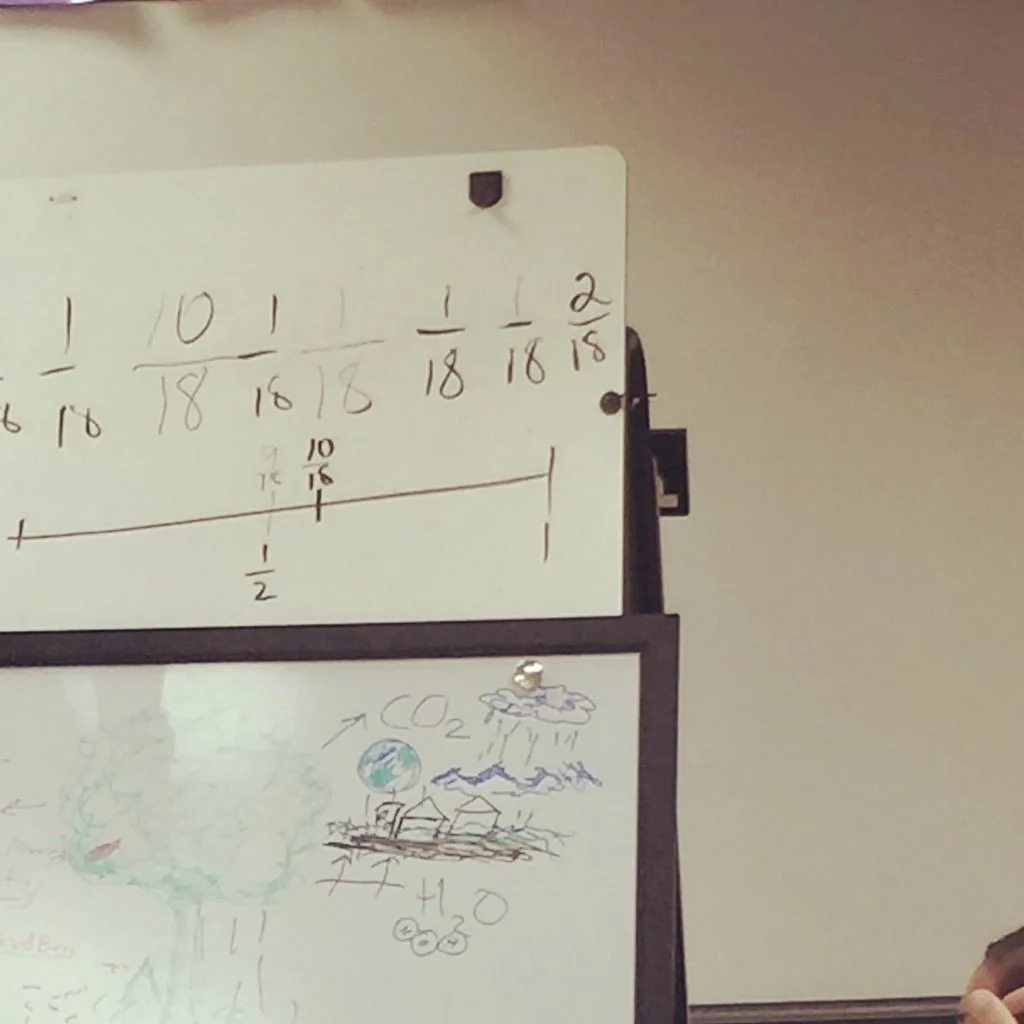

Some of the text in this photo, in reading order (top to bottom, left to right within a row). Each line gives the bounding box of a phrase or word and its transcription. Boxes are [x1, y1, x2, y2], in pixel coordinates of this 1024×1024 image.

[569, 271, 612, 313] 2
[425, 347, 465, 401] 18
[506, 337, 546, 385] 18
[307, 437, 335, 462] 10
[253, 581, 278, 602] 2
